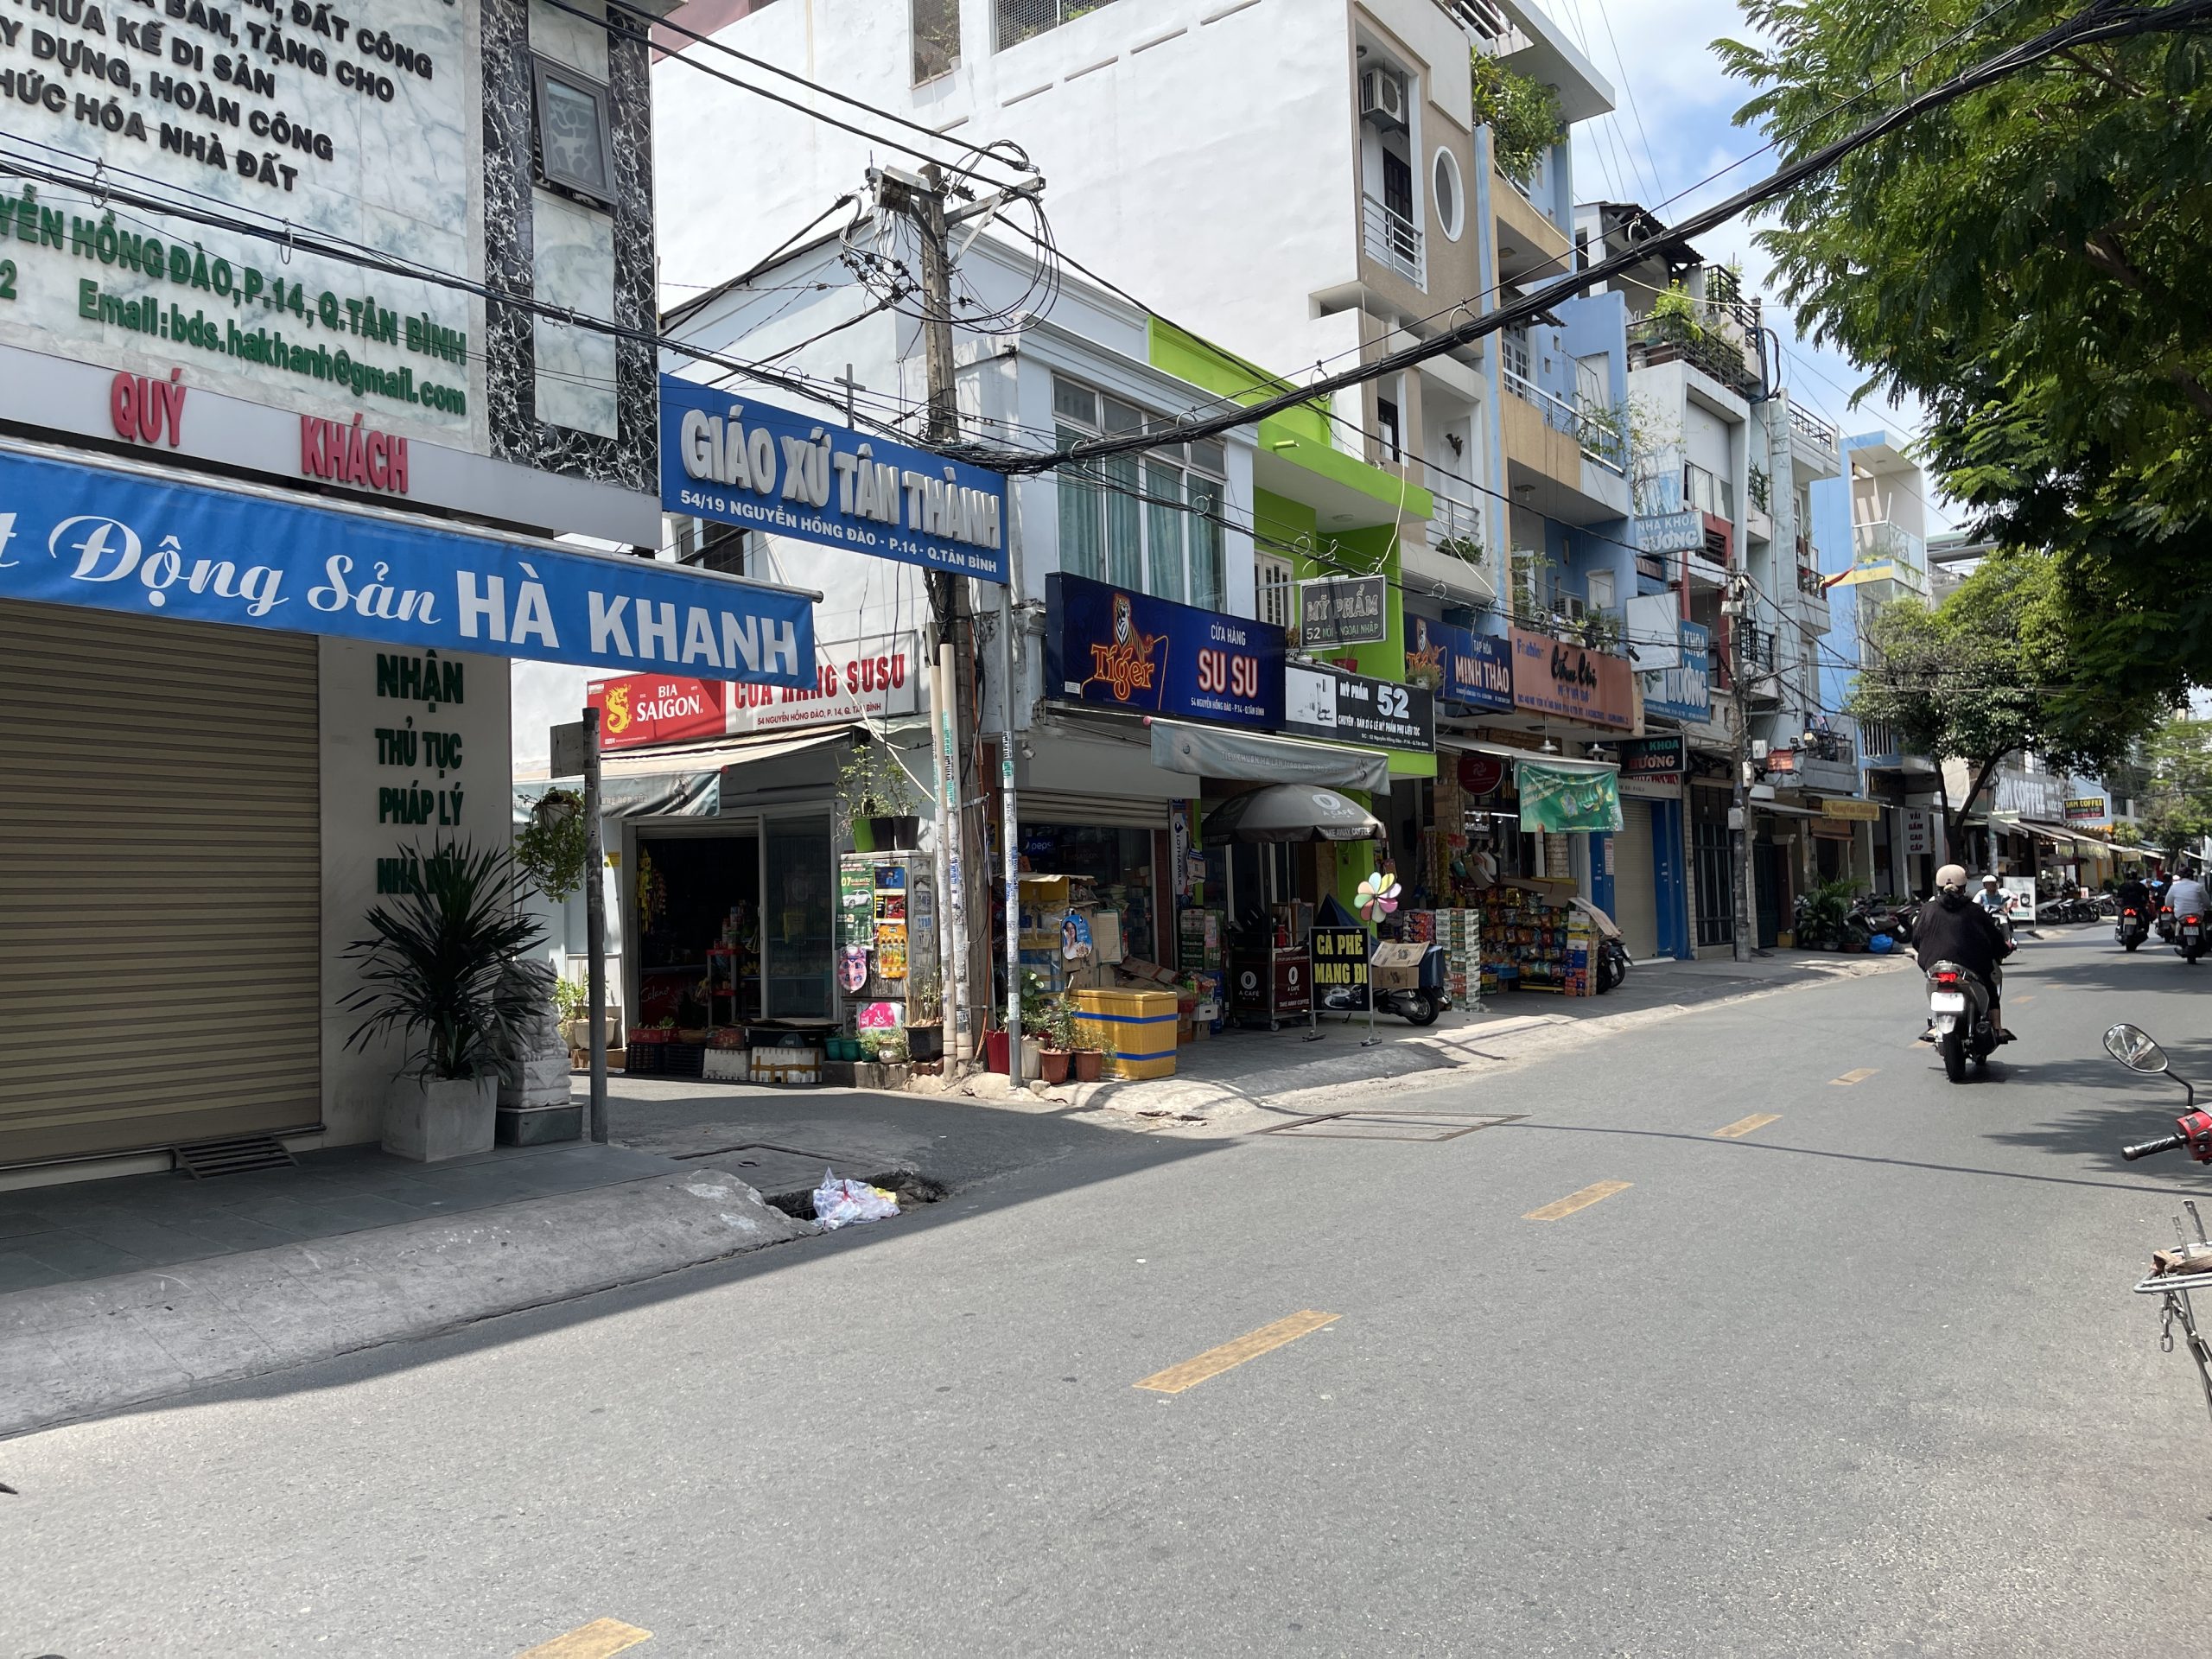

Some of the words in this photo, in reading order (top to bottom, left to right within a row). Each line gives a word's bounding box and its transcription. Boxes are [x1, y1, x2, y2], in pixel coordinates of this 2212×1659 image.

[117, 16, 165, 56] KẾ
[172, 37, 203, 72] DI
[213, 53, 275, 99] SẢN
[246, 21, 327, 76] TẶNG
[335, 60, 394, 102] CHO
[357, 29, 432, 79] CÔNG
[32, 29, 141, 97] DỰNG,
[150, 71, 240, 127] HOÀN
[249, 111, 334, 162] CÔNG
[74, 92, 147, 142] HÓA
[160, 122, 227, 170] NHÀ
[236, 149, 298, 191] ĐẤT
[405, 312, 467, 365] BÌNH
[111, 368, 187, 447] QUÝ
[301, 412, 409, 493] KHÁCH
[680, 404, 777, 496] GIÁO
[780, 427, 832, 508] XỨ
[833, 442, 900, 525] TÂN
[902, 467, 1001, 550] THÀNH
[680, 489, 725, 513] 54/19
[730, 505, 797, 529] NGUYỄN
[801, 516, 842, 539] HỒNG
[846, 526, 876, 546] ĐÀO
[889, 537, 917, 556] P.14
[927, 544, 965, 566] Q.TÂN
[968, 553, 997, 574] BÌNH
[1637, 520, 1661, 531] NHA
[1665, 513, 1697, 529] KHOA
[48, 515, 290, 617] Động
[307, 554, 442, 625] Sản
[456, 562, 559, 649] HÀ
[588, 590, 799, 676] KHANH
[1306, 594, 1330, 622] MỸ
[1333, 583, 1378, 620] PHẨM
[1306, 626, 1320, 640] 52
[1360, 620, 1378, 633] NHẬP
[1685, 630, 1706, 658] KHOA
[376, 648, 463, 713] NHẬN
[658, 684, 677, 698] BIA
[847, 653, 905, 695] SUSU
[1091, 642, 1155, 702] Tiger
[1211, 623, 1226, 643] CỬA
[1228, 626, 1246, 646] HÀNG
[1197, 648, 1227, 694] SU
[1231, 654, 1258, 698] SU
[1455, 654, 1482, 687] MINH
[1484, 657, 1510, 693] THẢO
[637, 695, 701, 721] SAIGON
[810, 709, 826, 720] ĐÀO,
[834, 708, 843, 716] 14,
[867, 702, 881, 713] BÌNH
[1191, 696, 1197, 706] 54
[1377, 684, 1409, 719] 52
[375, 717, 416, 766] THỦ
[423, 728, 462, 779] TỤC
[1649, 740, 1679, 751] KHOA
[378, 780, 433, 825] PHÁP
[439, 782, 463, 826] LÝ
[2013, 779, 2045, 816] COFFEE
[2080, 799, 2102, 808] COFFEE
[1351, 827, 1370, 836] COFFEE
[1317, 928, 1334, 956] CÀ
[1337, 928, 1363, 956] PHÊ
[1314, 963, 1351, 984] MANG
[1354, 963, 1368, 984] ĐI
